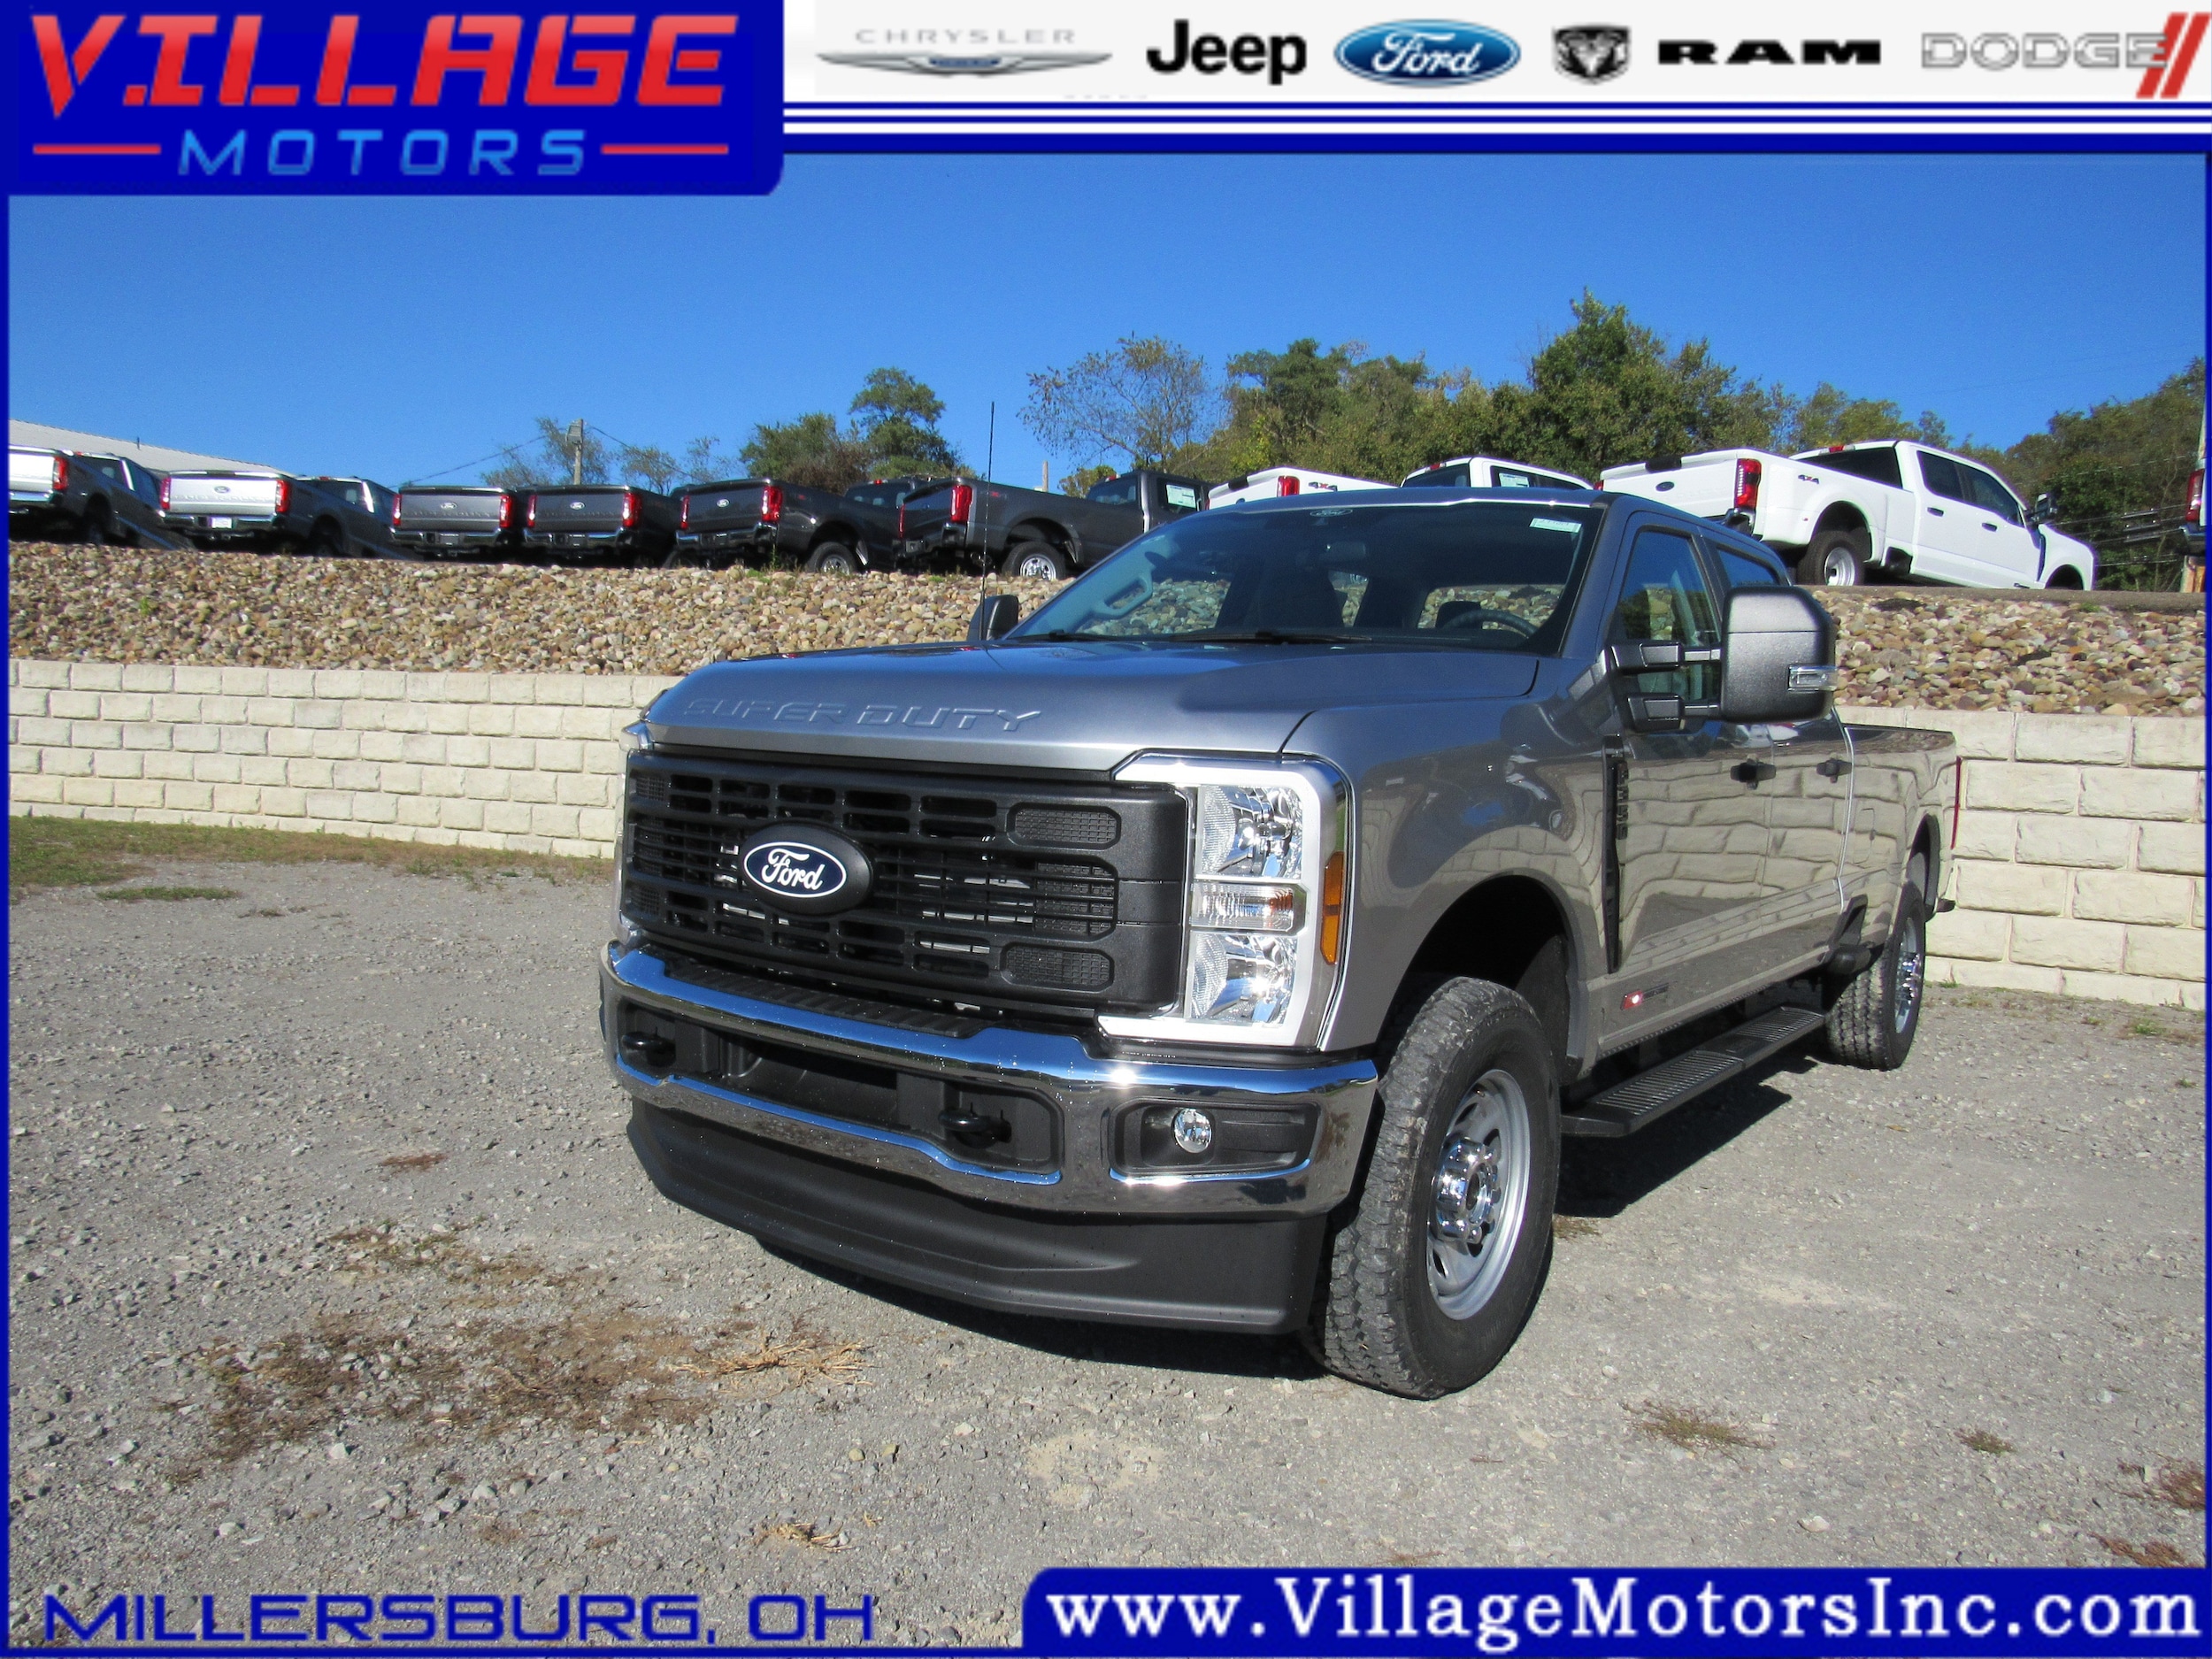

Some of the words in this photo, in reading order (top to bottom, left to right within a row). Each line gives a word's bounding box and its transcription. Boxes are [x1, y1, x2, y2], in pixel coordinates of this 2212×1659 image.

[683, 697, 848, 725] SUPER
[856, 705, 1042, 732] DUTY
[762, 848, 826, 891] Ford
